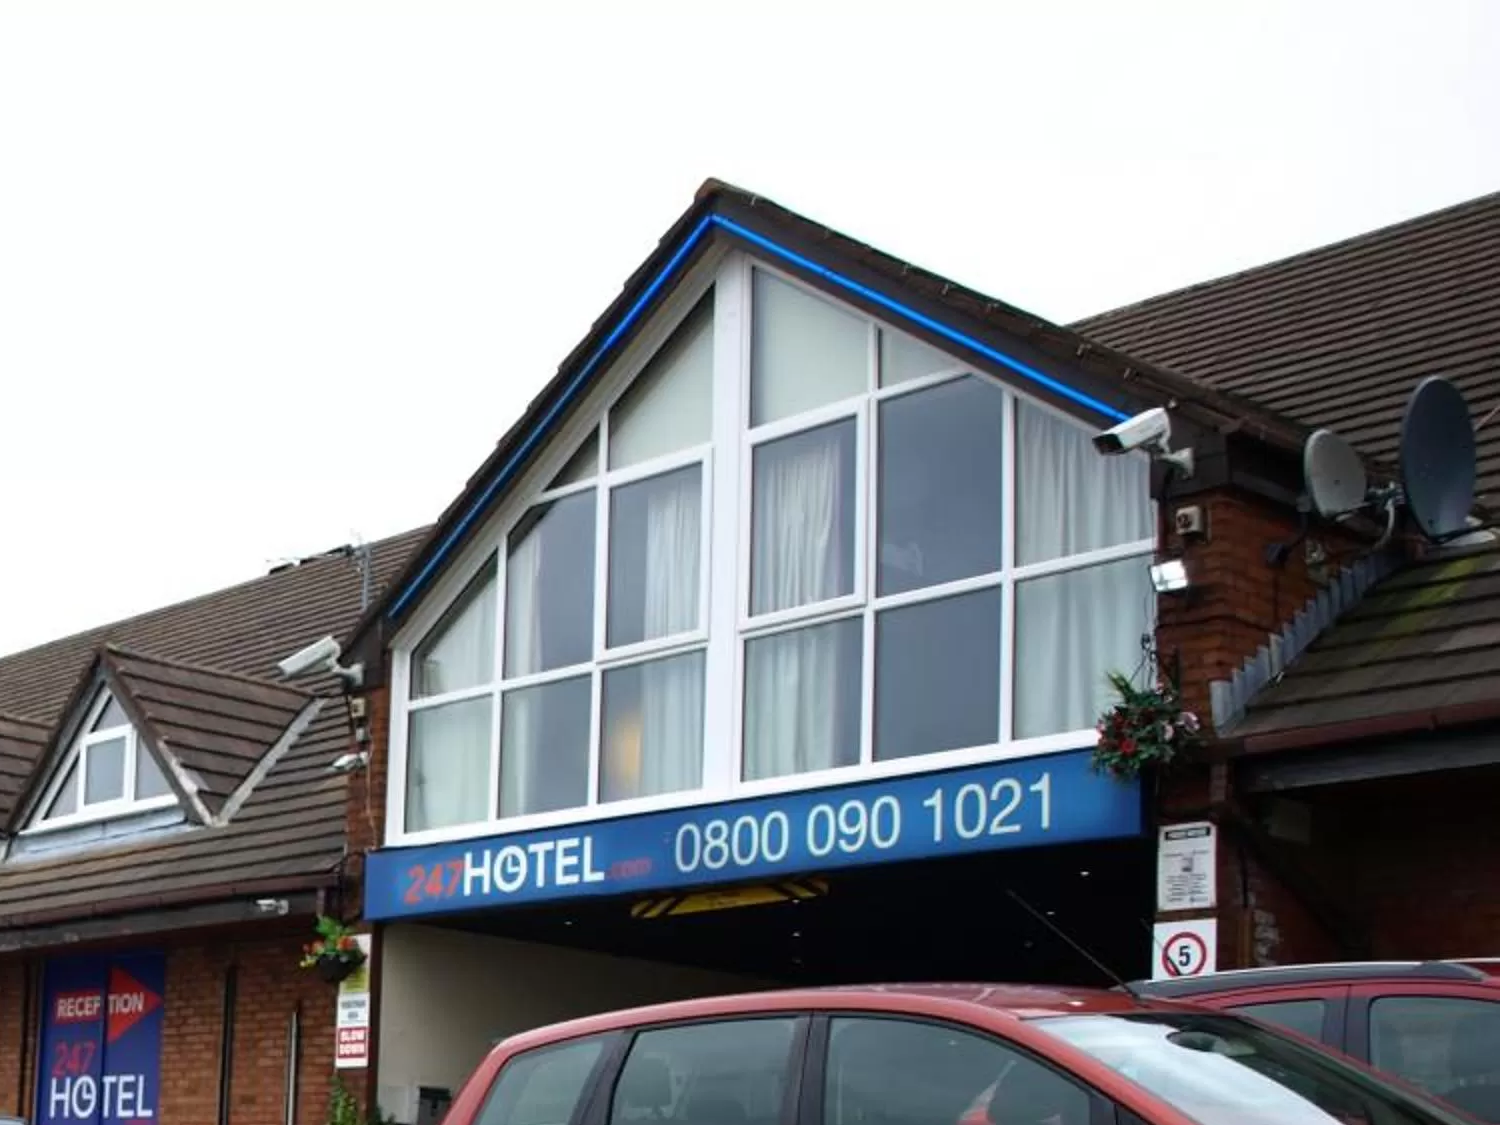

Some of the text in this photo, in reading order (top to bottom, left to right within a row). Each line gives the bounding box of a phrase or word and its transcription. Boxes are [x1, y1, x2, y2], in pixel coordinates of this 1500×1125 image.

[675, 811, 789, 873] 0800
[807, 795, 901, 857] 090
[923, 772, 1051, 843] 1021
[1178, 945, 1191, 967] 5
[51, 1040, 97, 1076] 247
[49, 1074, 153, 1119] HOTEL
